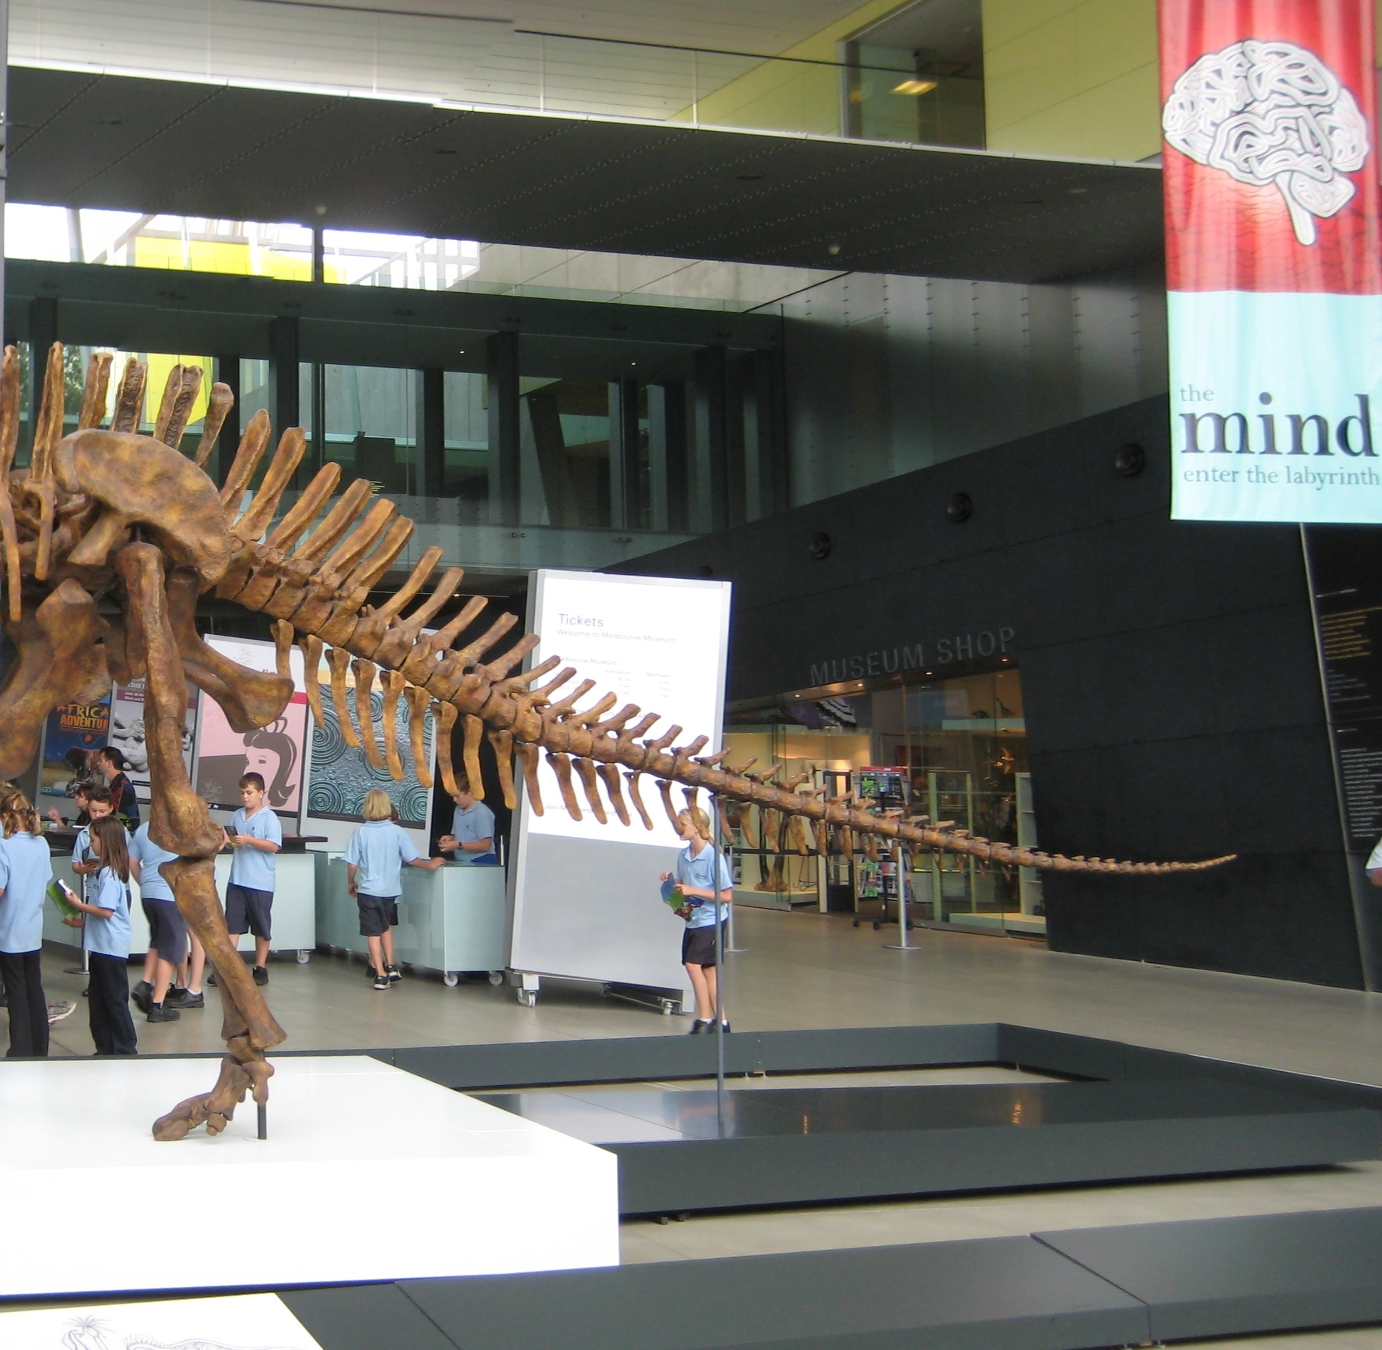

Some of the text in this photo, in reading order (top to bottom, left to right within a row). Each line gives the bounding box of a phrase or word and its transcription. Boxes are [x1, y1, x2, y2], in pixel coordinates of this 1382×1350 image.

[1179, 384, 1215, 402] the
[1178, 391, 1380, 458] mind
[1183, 465, 1381, 491] enter the labyrinth
[558, 613, 604, 627] Tickets
[557, 628, 590, 638] Welcome
[602, 631, 641, 641] Melbourne
[643, 635, 676, 643] Museum
[561, 656, 588, 664] elbourne
[810, 626, 1015, 686] MUSEUM SHOP
[60, 714, 108, 729] ADVENTUR
